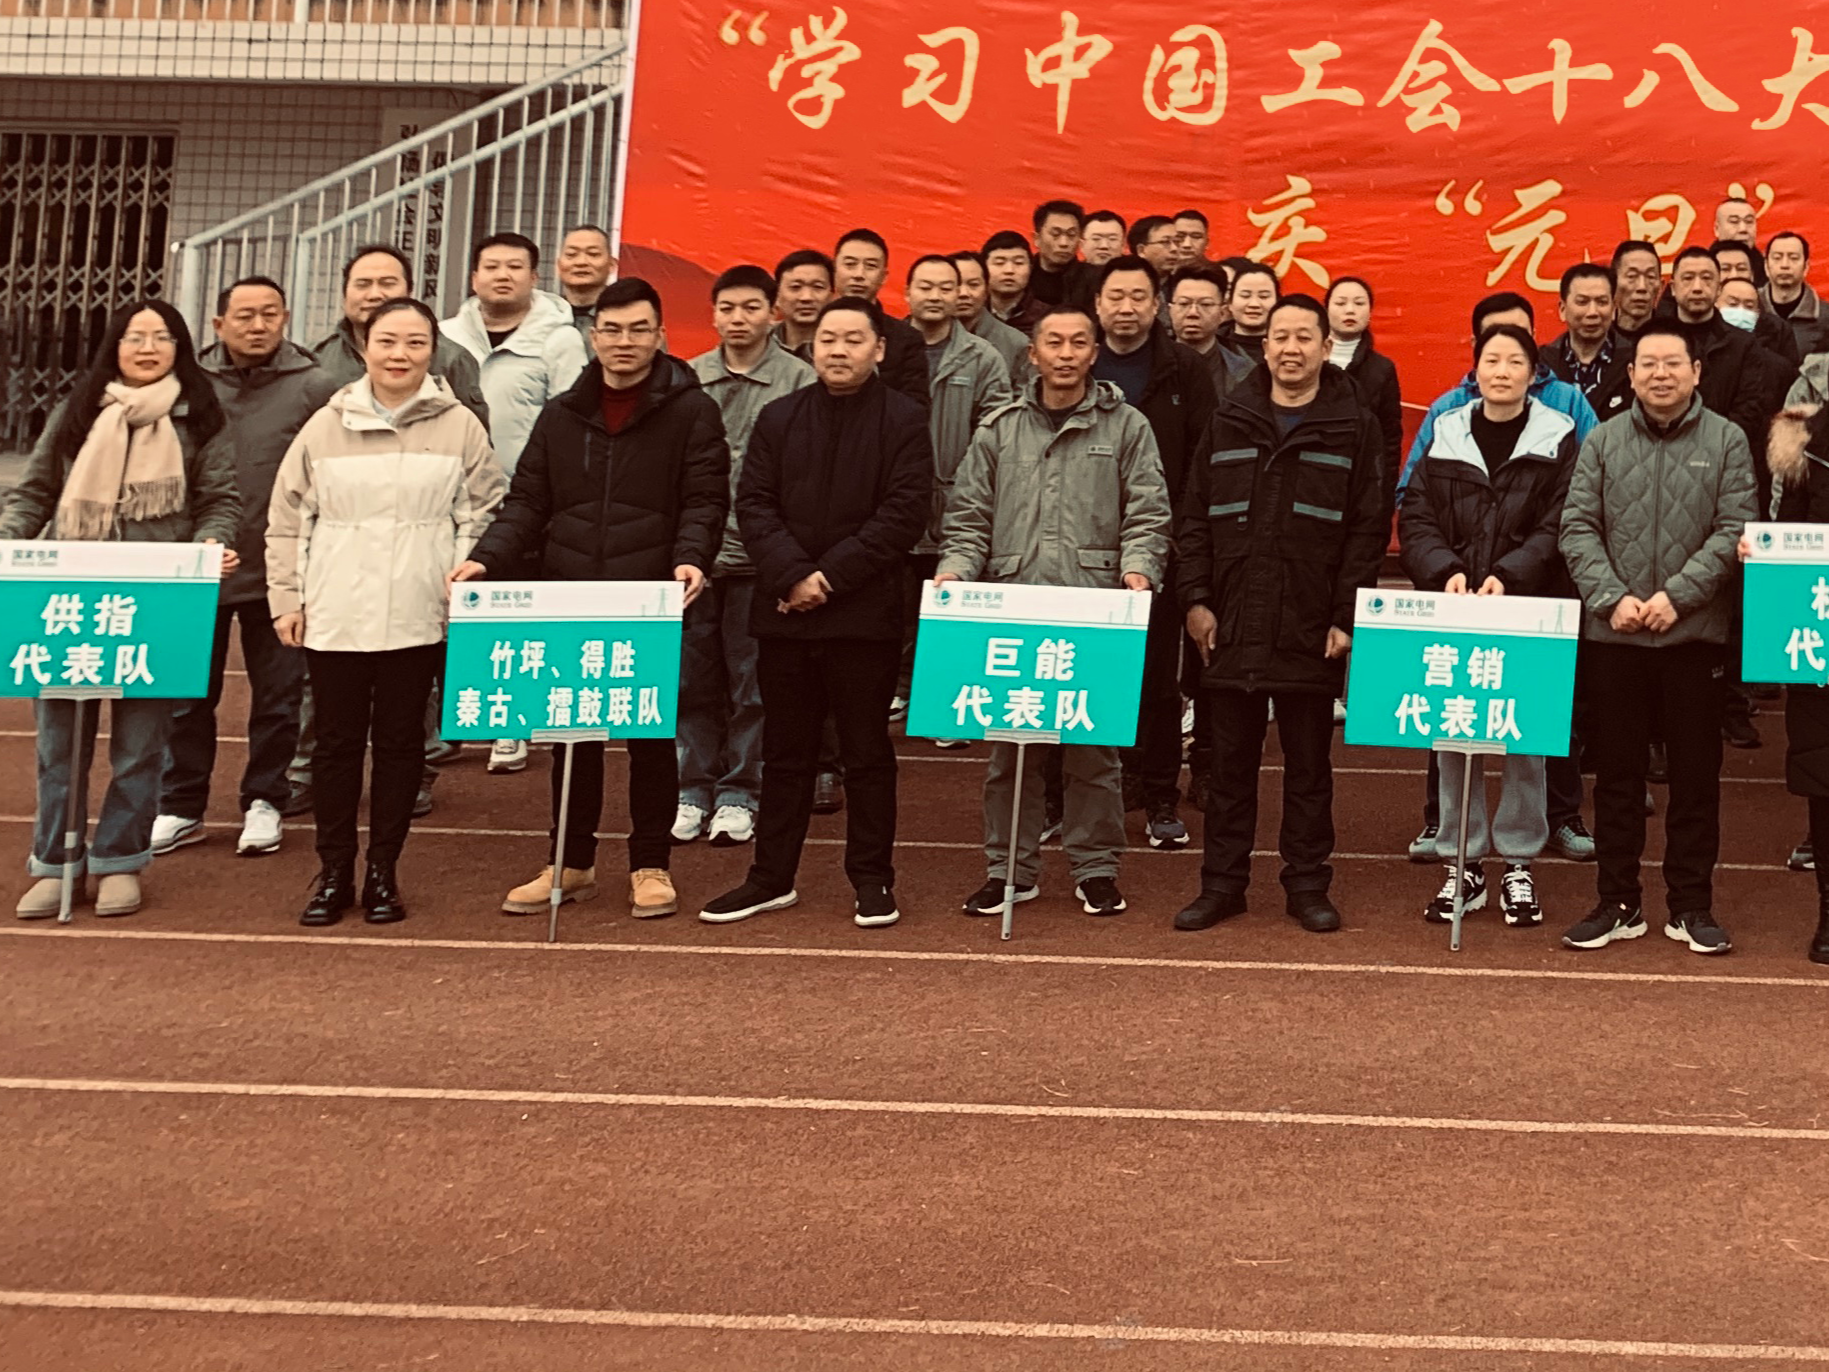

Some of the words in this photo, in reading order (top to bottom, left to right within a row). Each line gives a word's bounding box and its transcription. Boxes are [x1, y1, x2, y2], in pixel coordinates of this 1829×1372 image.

[41, 593, 137, 636] 供指
[962, 590, 1003, 602] 国家电网
[1394, 598, 1435, 610] 国家电网
[9, 643, 155, 685] 代表队
[490, 640, 636, 679] 竹坪、得胜
[985, 638, 1076, 681] 巨能
[1422, 643, 1506, 690] 营销
[456, 686, 662, 728] 秦古、擂鼓联队
[952, 685, 1095, 731] 代表队
[1394, 693, 1522, 741] 代表队
